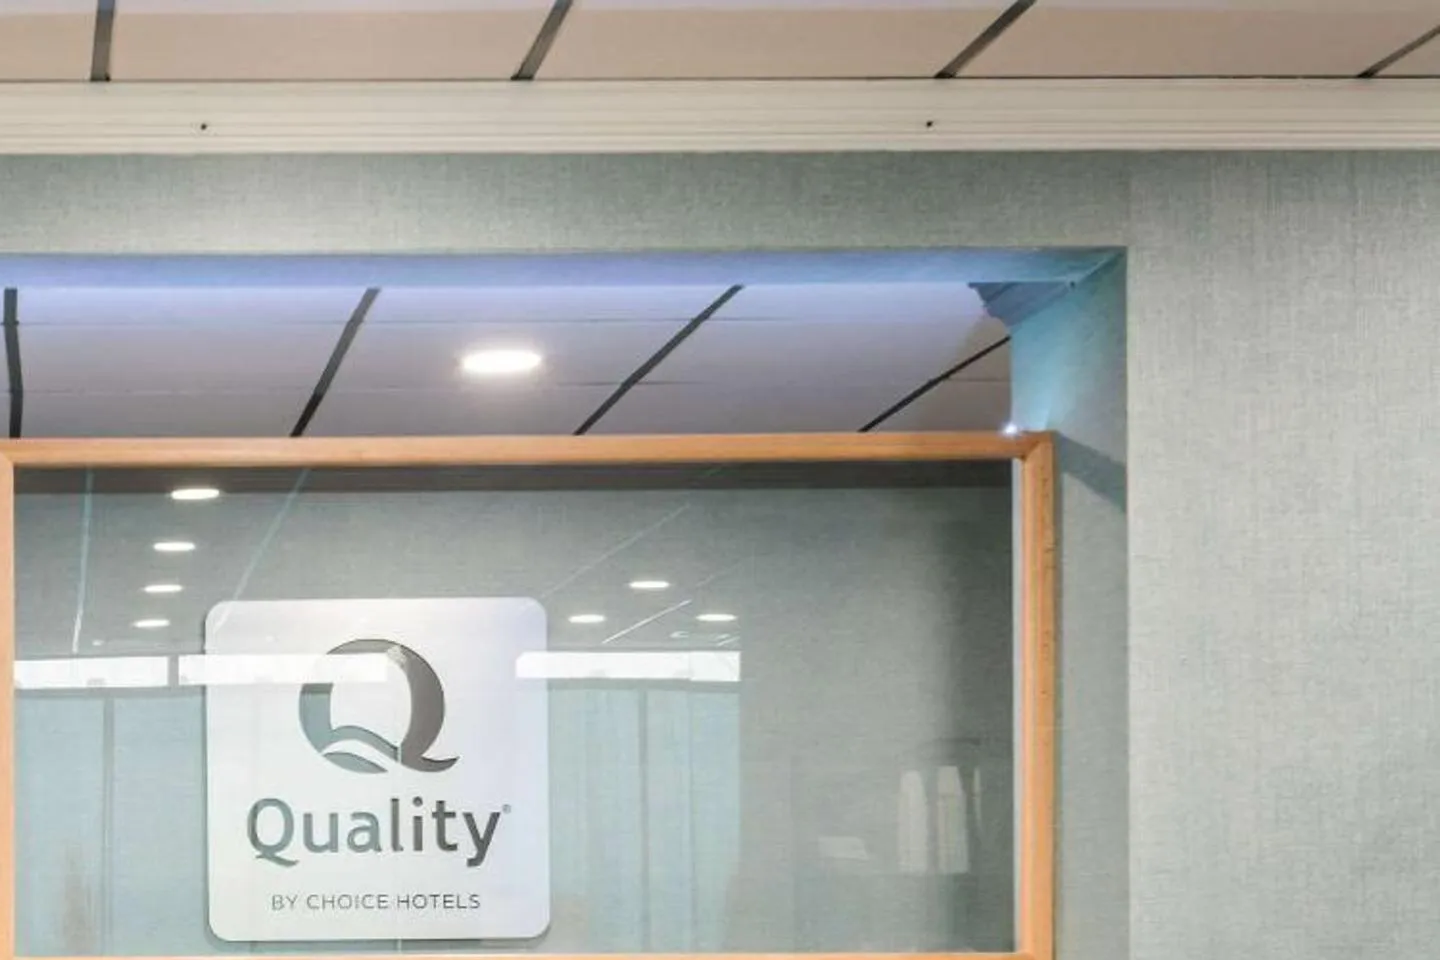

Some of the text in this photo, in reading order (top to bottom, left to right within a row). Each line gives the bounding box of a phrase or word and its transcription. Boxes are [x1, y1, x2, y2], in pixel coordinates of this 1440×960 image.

[246, 796, 501, 867] Quality
[271, 894, 481, 911] BY CHOICE HOTELS
